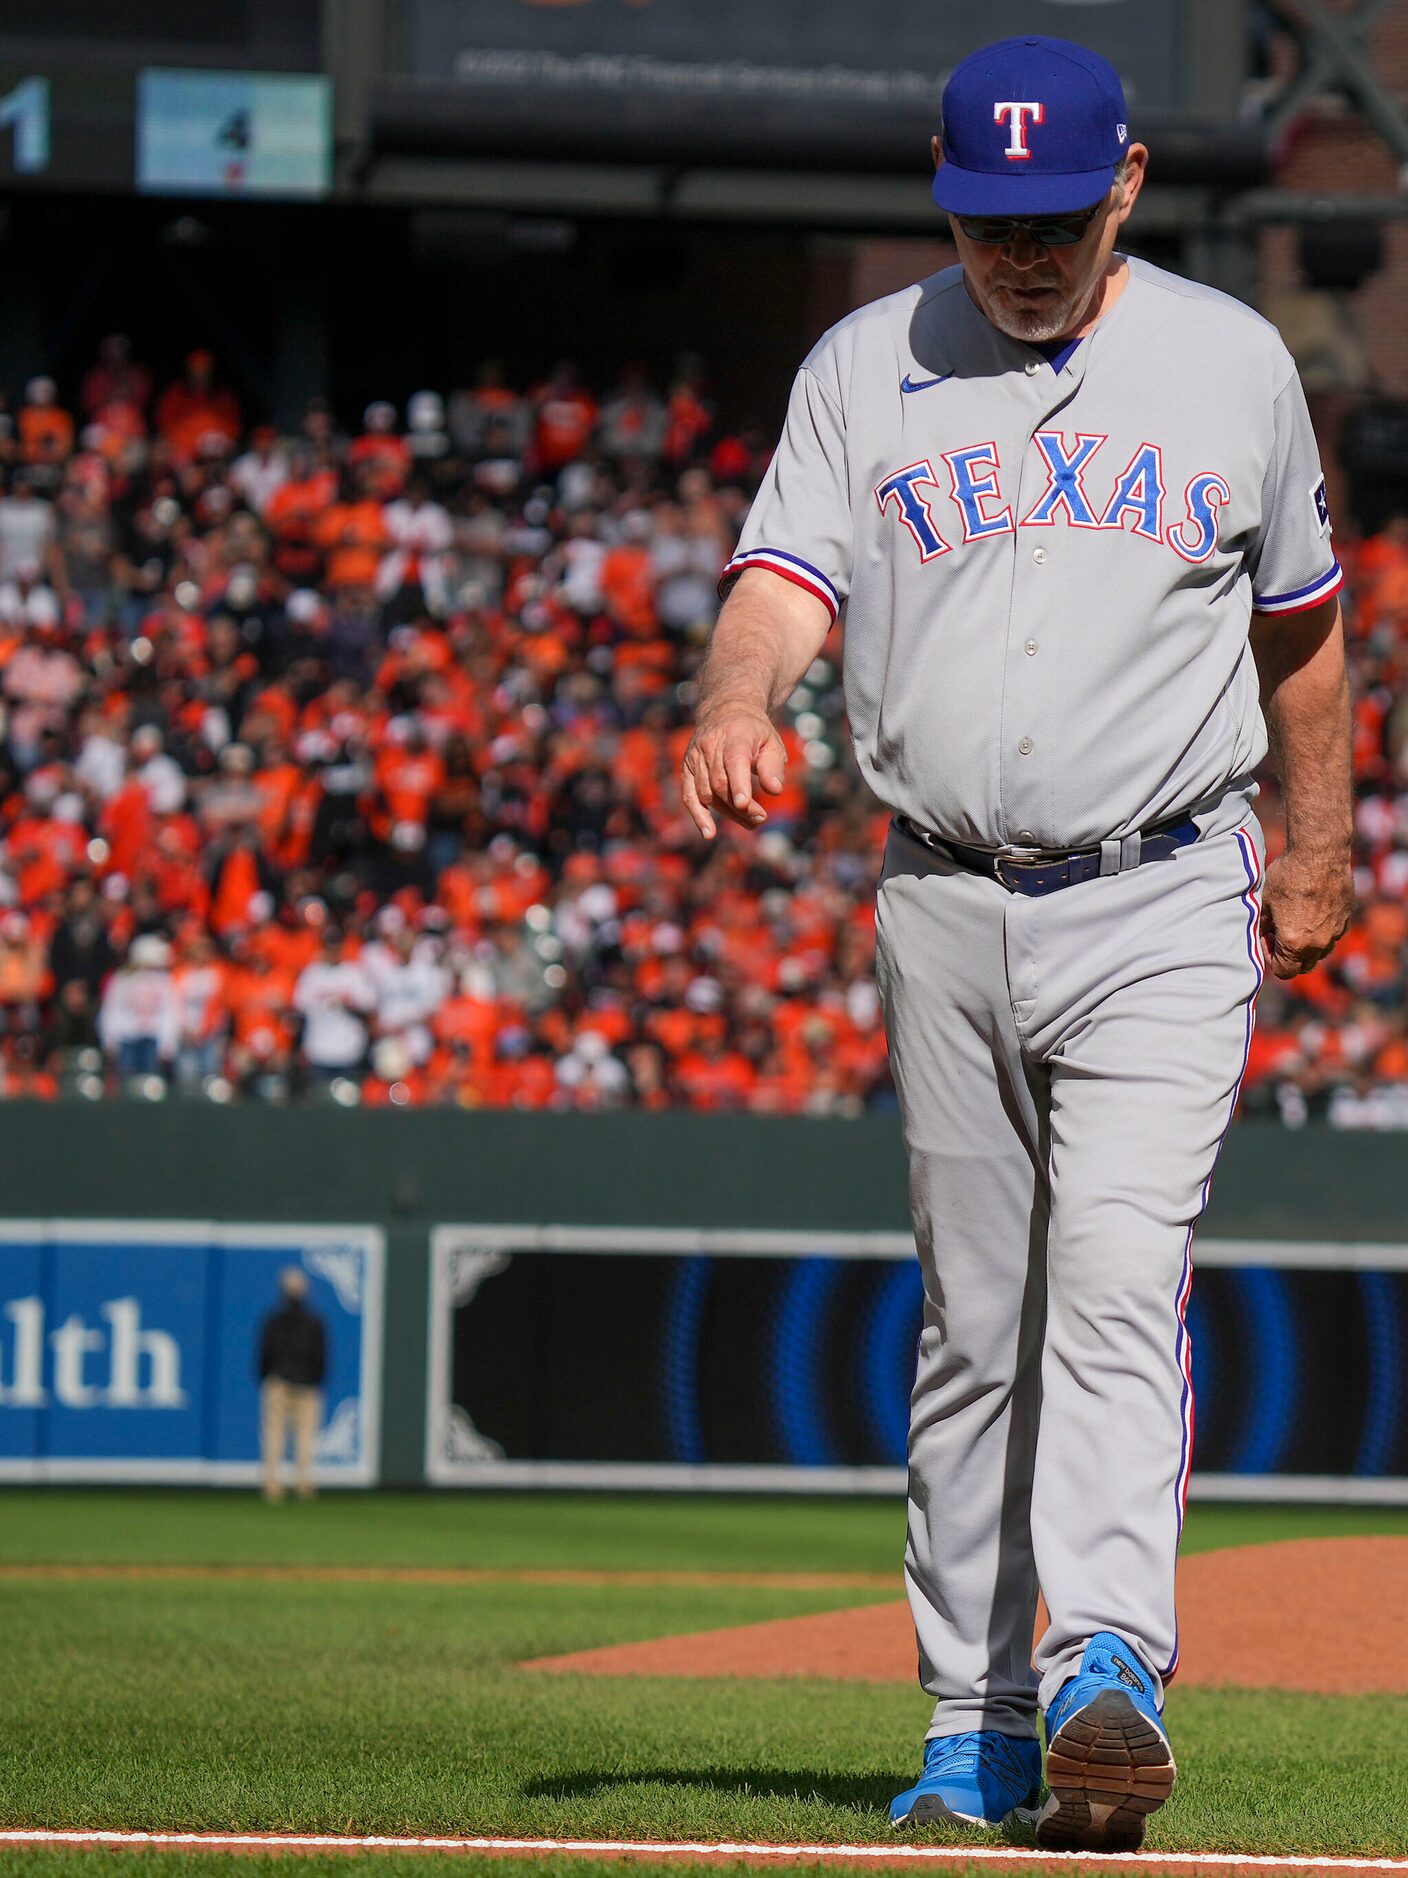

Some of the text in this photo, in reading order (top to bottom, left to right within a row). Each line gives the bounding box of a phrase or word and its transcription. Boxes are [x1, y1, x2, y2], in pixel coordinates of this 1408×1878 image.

[994, 101, 1044, 160] T
[875, 431, 1230, 564] TEXAS
[0, 1295, 188, 1409] lth
[1113, 1658, 1144, 1692] new balance
